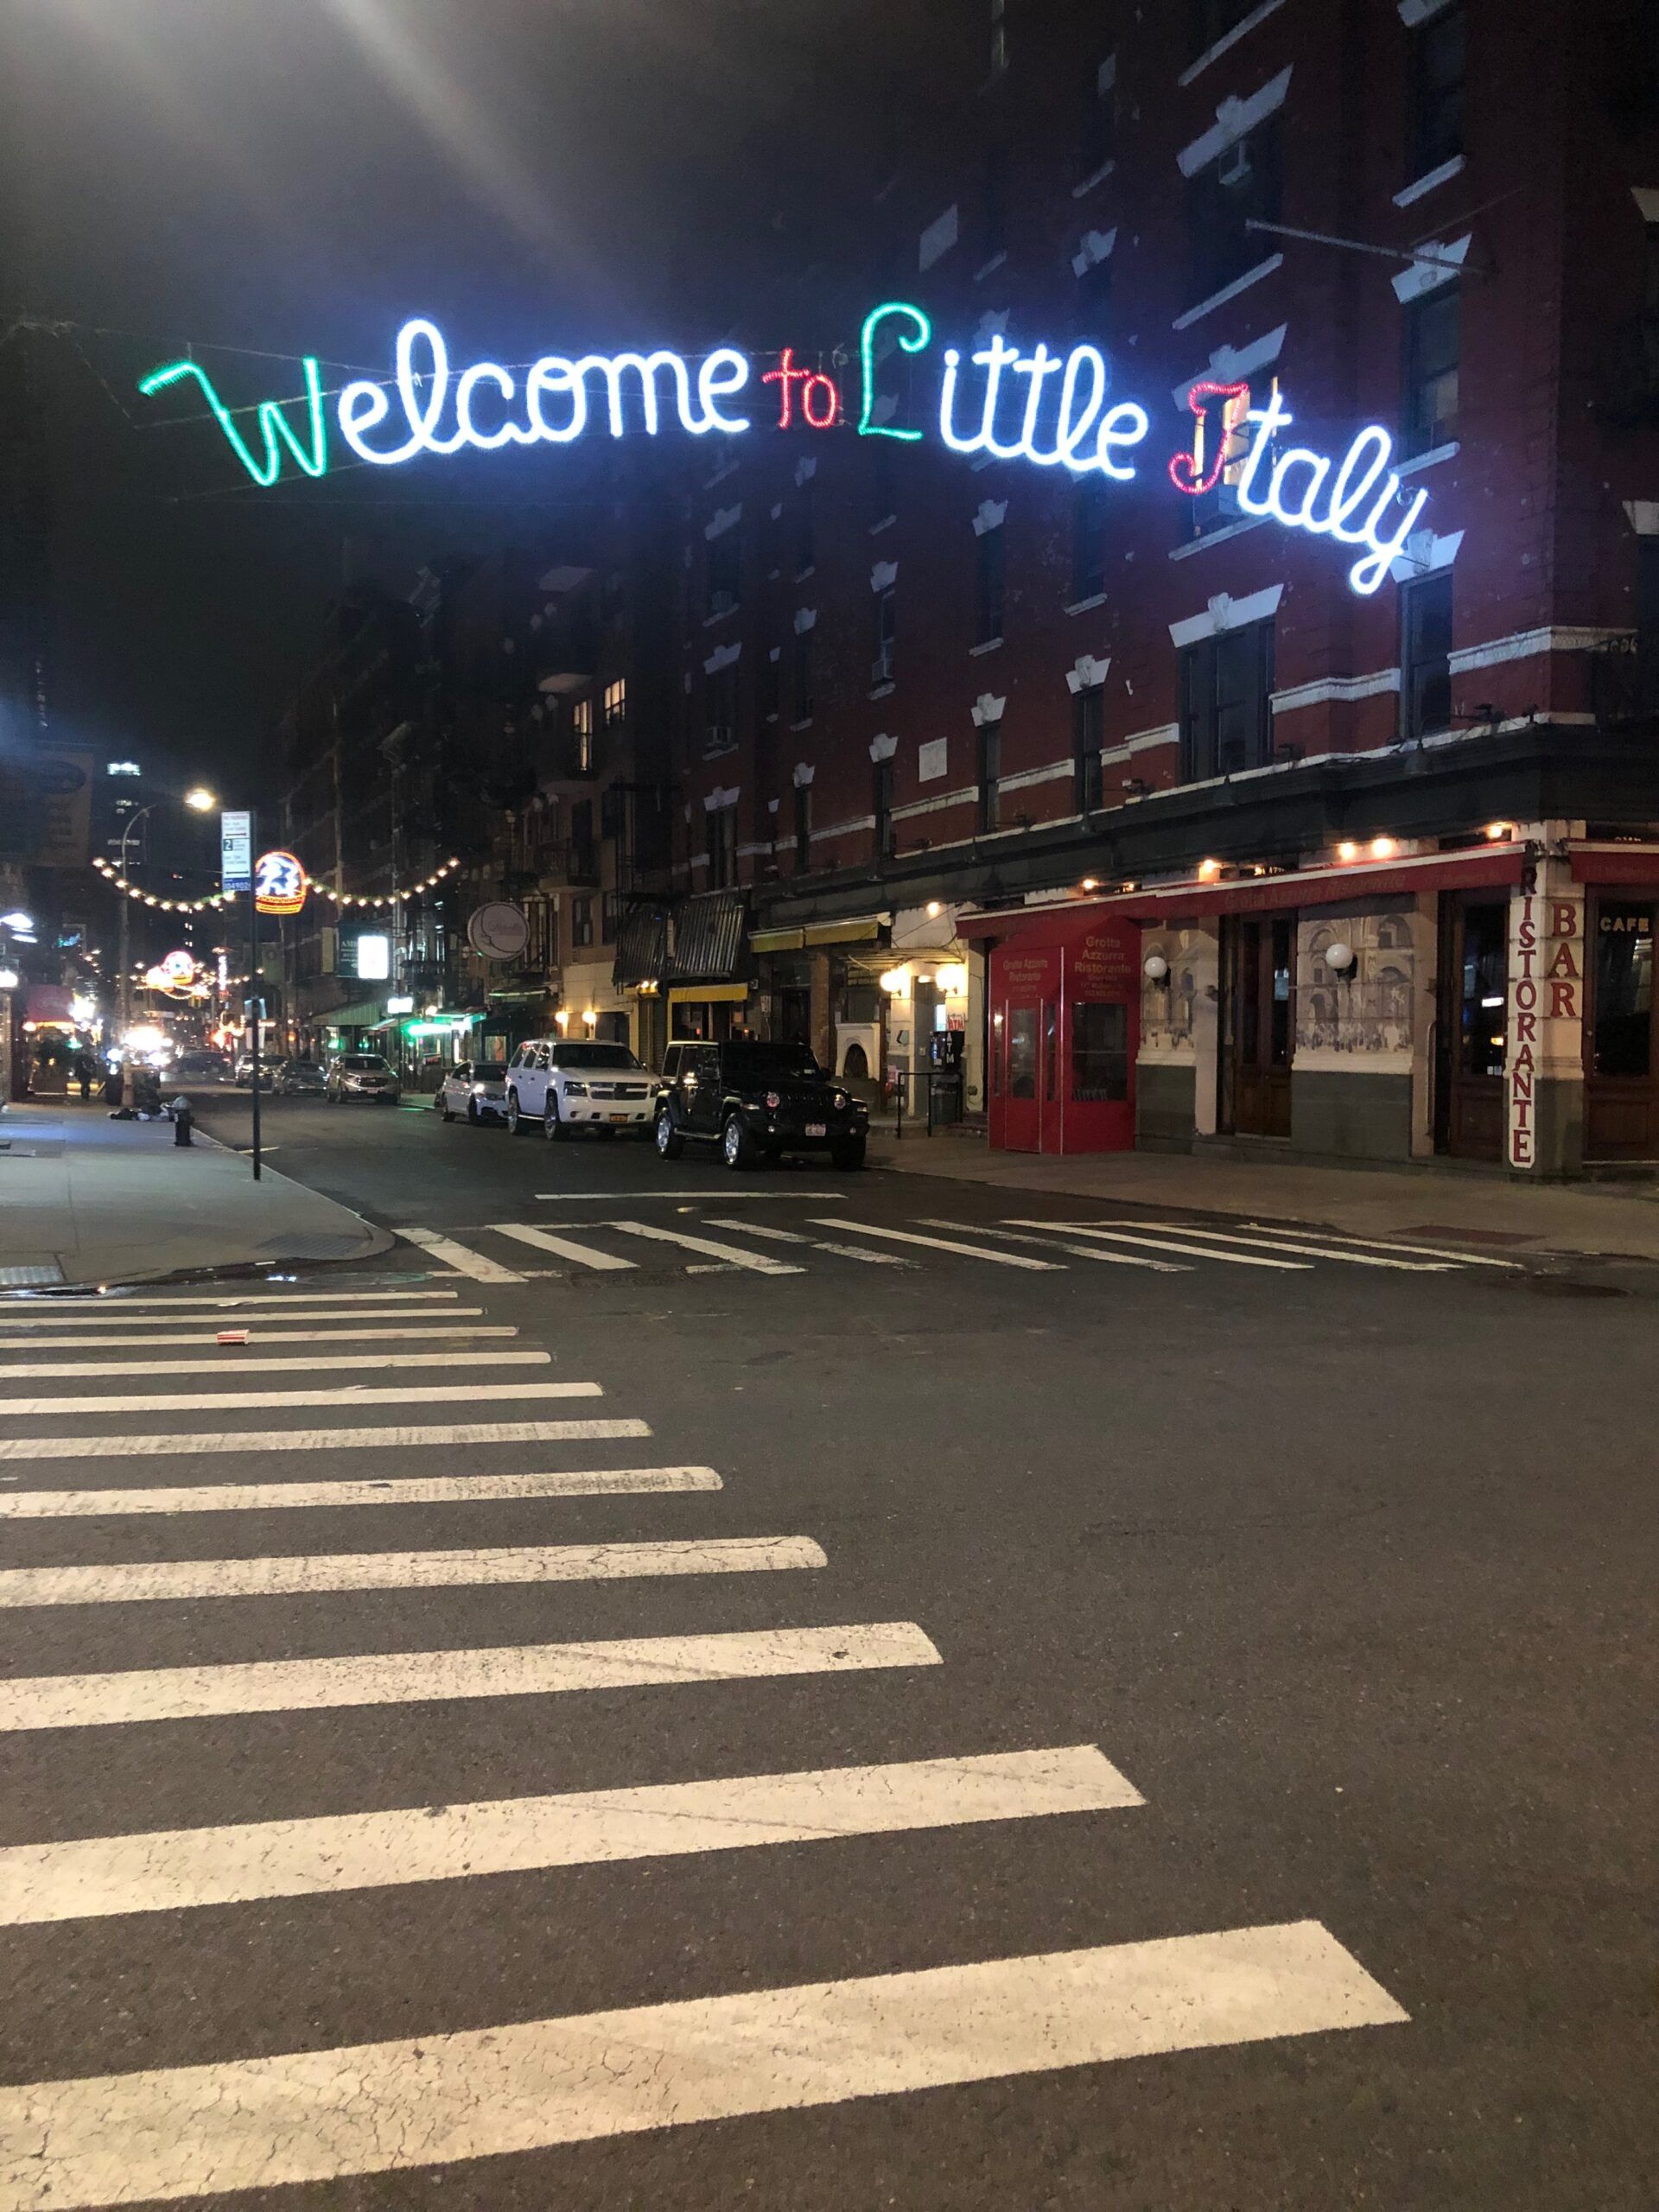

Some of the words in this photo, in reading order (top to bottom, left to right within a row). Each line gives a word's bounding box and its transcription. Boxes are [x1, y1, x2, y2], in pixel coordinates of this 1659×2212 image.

[139, 318, 751, 486] Welcome
[762, 347, 839, 430] to
[857, 302, 1149, 480] Little
[1167, 381, 1428, 596] Italy
[225, 839, 232, 851] 2
[1599, 917, 1649, 932] CAFE
[1086, 936, 1121, 948] Grotta
[1082, 949, 1125, 961] Azzurra
[1550, 902, 1580, 1018] BAR
[1074, 962, 1132, 975] Ristorante
[1511, 866, 1538, 1163] RISTORANTE
[948, 1019, 964, 1031] ATM
[946, 1032, 955, 1064] ATM
